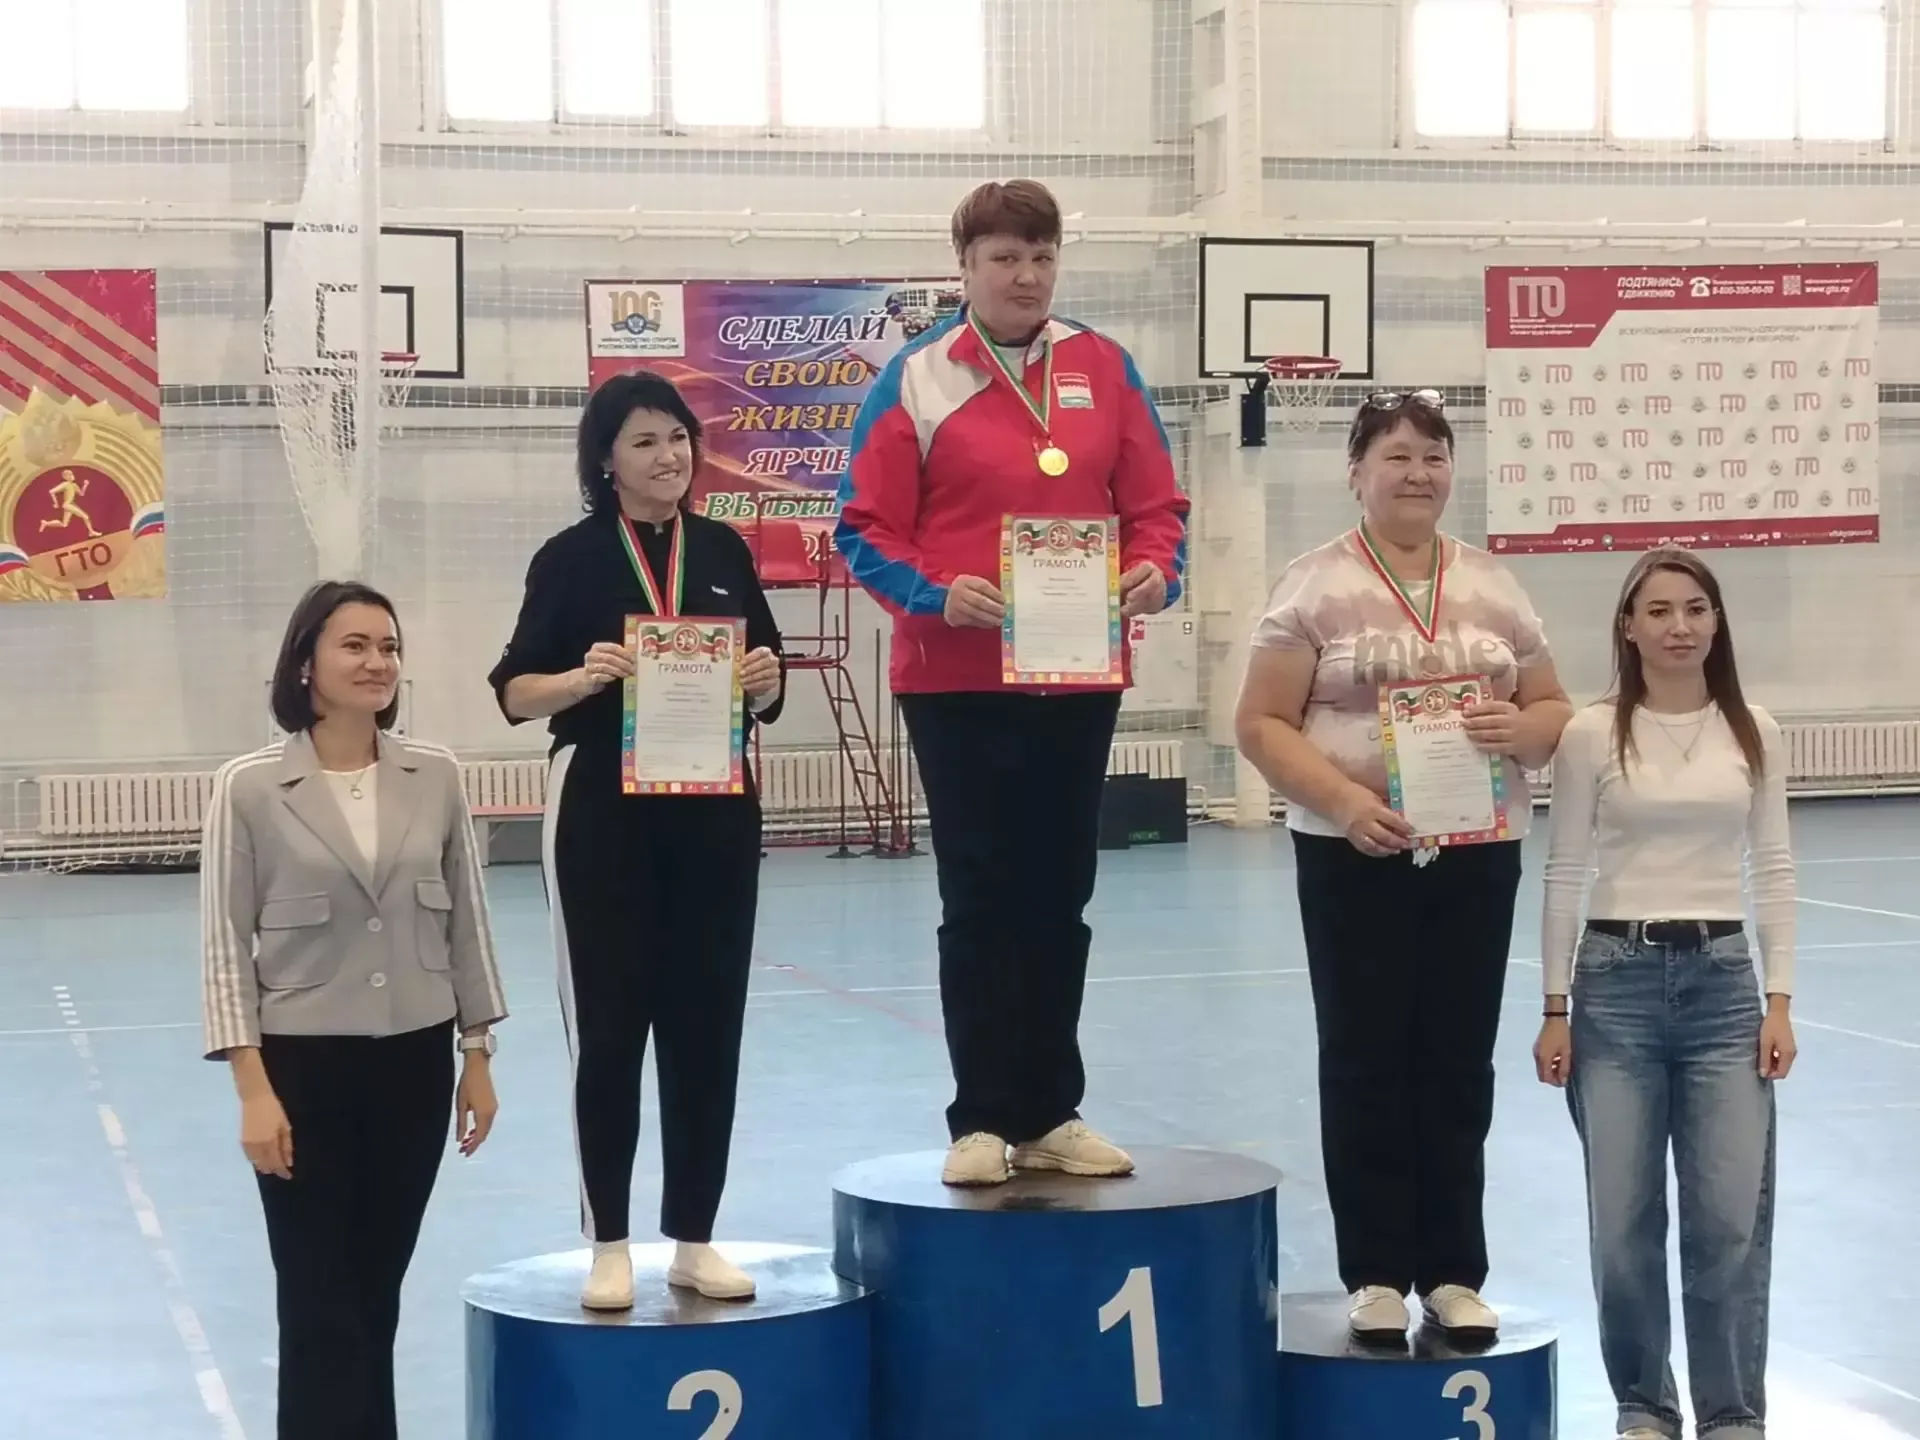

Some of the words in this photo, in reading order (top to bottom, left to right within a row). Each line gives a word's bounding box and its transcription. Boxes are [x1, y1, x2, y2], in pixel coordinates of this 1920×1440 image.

[1617, 276, 1684, 288] ПОДТЯНИСЬ
[1508, 276, 1566, 317] ГТО
[719, 309, 891, 350] СДЕЛАЙ
[743, 360, 871, 387] СВОЮ
[1546, 364, 1572, 383] ГТО
[1621, 363, 1647, 382] ГТО
[1697, 362, 1723, 381] ГТО
[1771, 361, 1797, 379] ГТО
[1844, 358, 1870, 377] ГТО
[1499, 398, 1525, 417] ГТО
[1569, 397, 1596, 416] ГТО
[1645, 395, 1671, 415] ГТО
[1720, 394, 1746, 413] ГТО
[1794, 392, 1820, 411] ГТО
[727, 404, 859, 431] ЖИЗН
[1547, 430, 1573, 449] ГТО
[1623, 429, 1648, 448] ГТО
[1698, 427, 1723, 446] ГТО
[1772, 425, 1799, 444] ГТО
[1845, 423, 1870, 442] ГТО
[740, 447, 851, 475] ЯРЧЕ
[1646, 461, 1673, 480] ГТО
[1720, 459, 1747, 478] ГТО
[1795, 457, 1819, 476] ГТО
[1500, 464, 1526, 483] ГТО
[1570, 463, 1597, 482] ГТО
[705, 491, 839, 519] ВЫБИ
[1548, 496, 1575, 516] ГТО
[1622, 494, 1650, 513] ГТО
[1699, 492, 1724, 512] ГТО
[1774, 490, 1798, 509] ГТО
[1847, 488, 1871, 507] ГТО
[54, 542, 112, 577] ГТО
[1033, 559, 1087, 569] ГРАМОТА
[658, 663, 713, 674] ГРАМОТА
[1413, 720, 1465, 735] ГРАМОТА
[1098, 1266, 1163, 1408] 1
[667, 1369, 743, 1440] 2
[1441, 1370, 1496, 1440] 3
